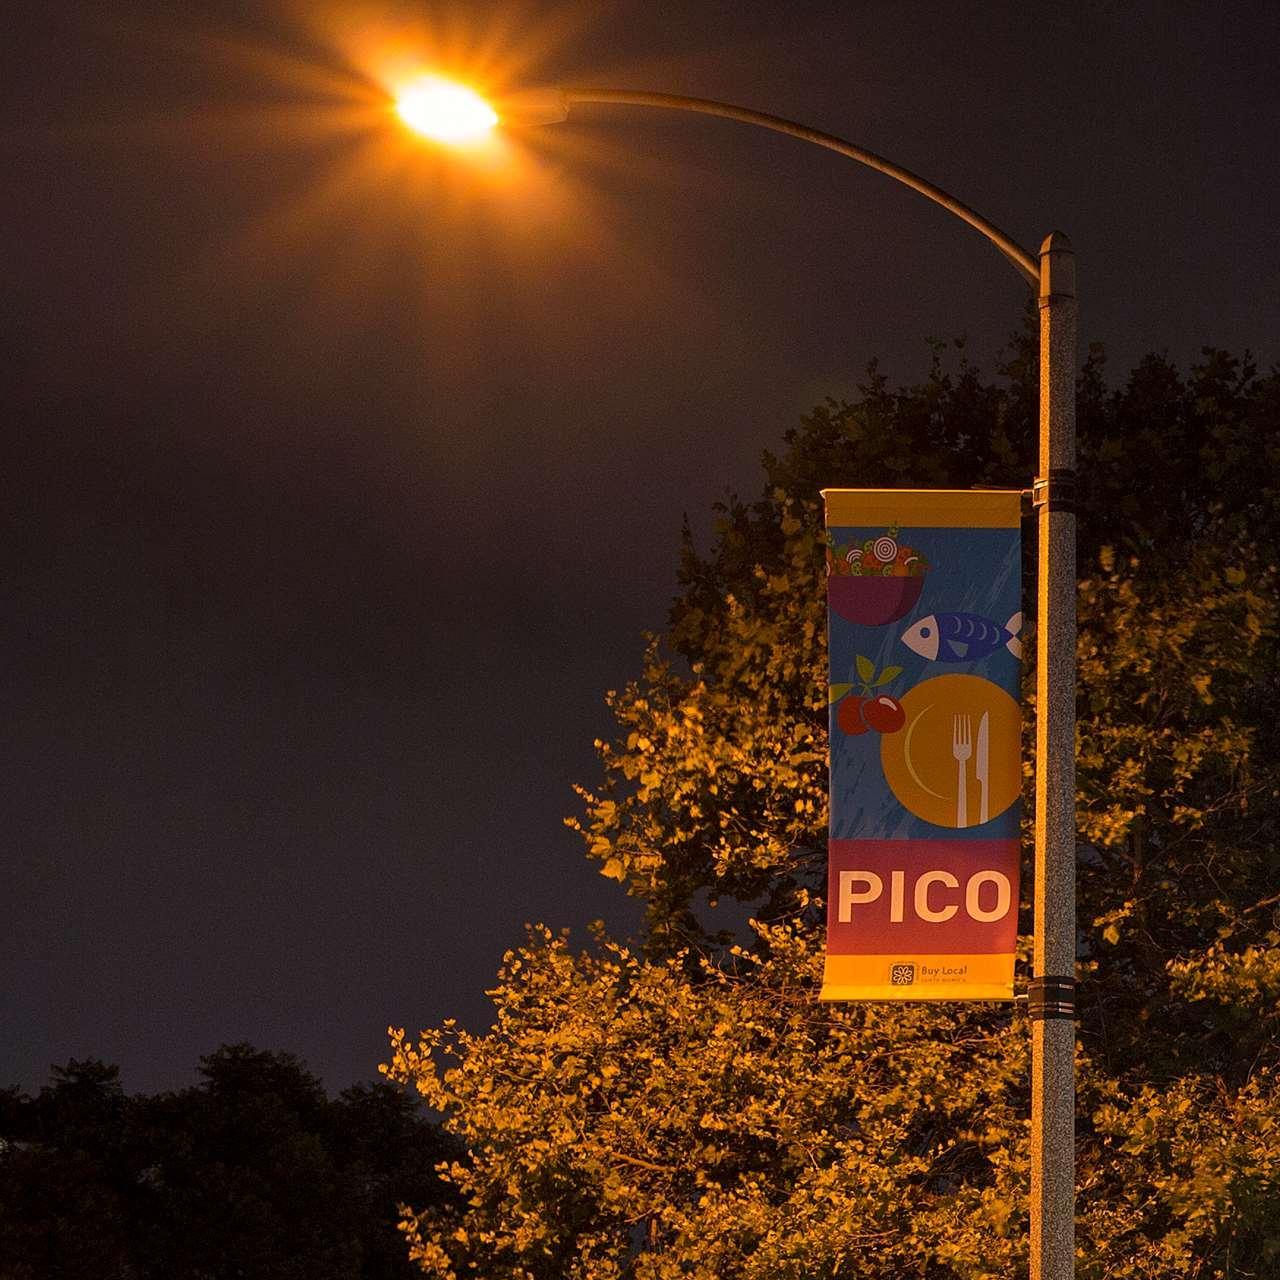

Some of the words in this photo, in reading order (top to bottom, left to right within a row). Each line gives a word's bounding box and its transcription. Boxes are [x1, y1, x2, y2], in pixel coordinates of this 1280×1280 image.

[838, 870, 1011, 923] PICO
[921, 966, 939, 977] Buy
[942, 965, 968, 976] Local
